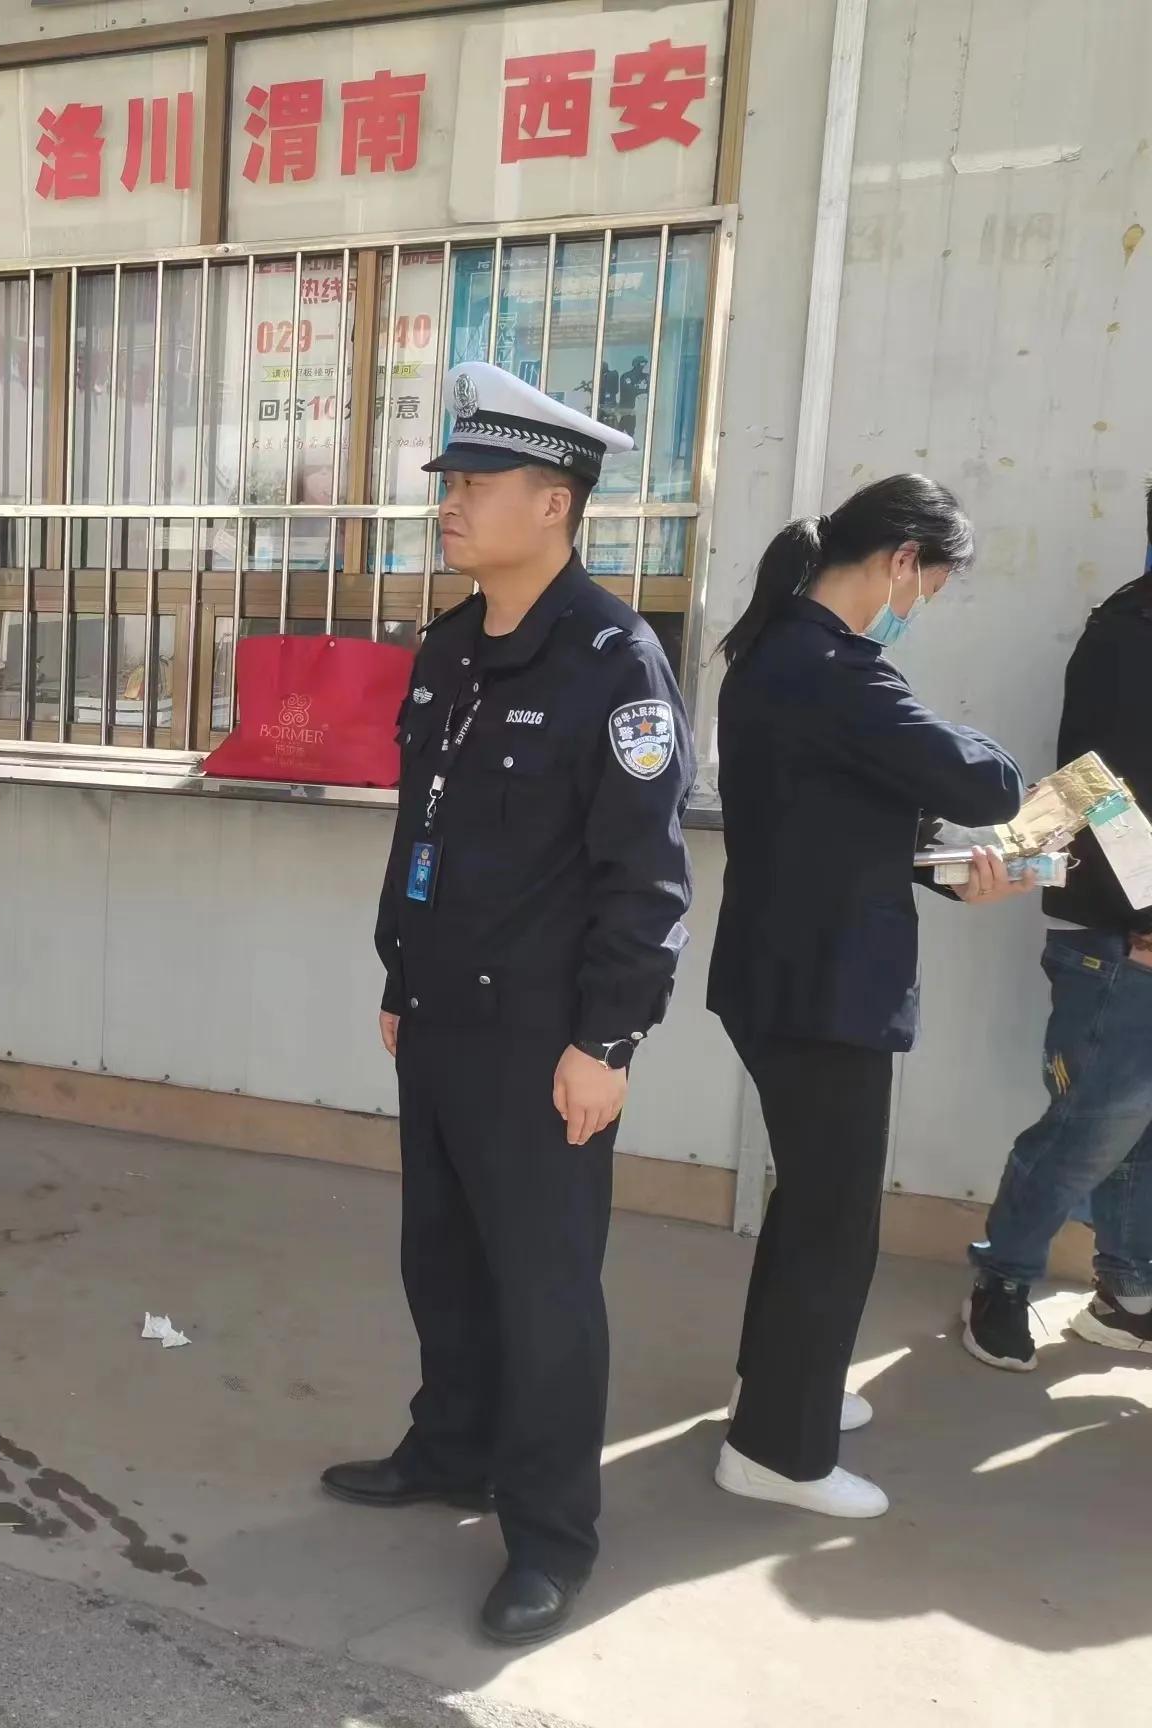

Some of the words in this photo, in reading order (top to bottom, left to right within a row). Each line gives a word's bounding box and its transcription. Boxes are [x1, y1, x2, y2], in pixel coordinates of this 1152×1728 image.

[34, 91, 195, 200] 洛川
[242, 69, 427, 184] 渭南
[499, 39, 708, 164] 西安
[256, 313, 432, 354] 029-40
[454, 716, 473, 746] POLICE
[505, 709, 545, 725] BS1016
[259, 723, 325, 745] BORMER
